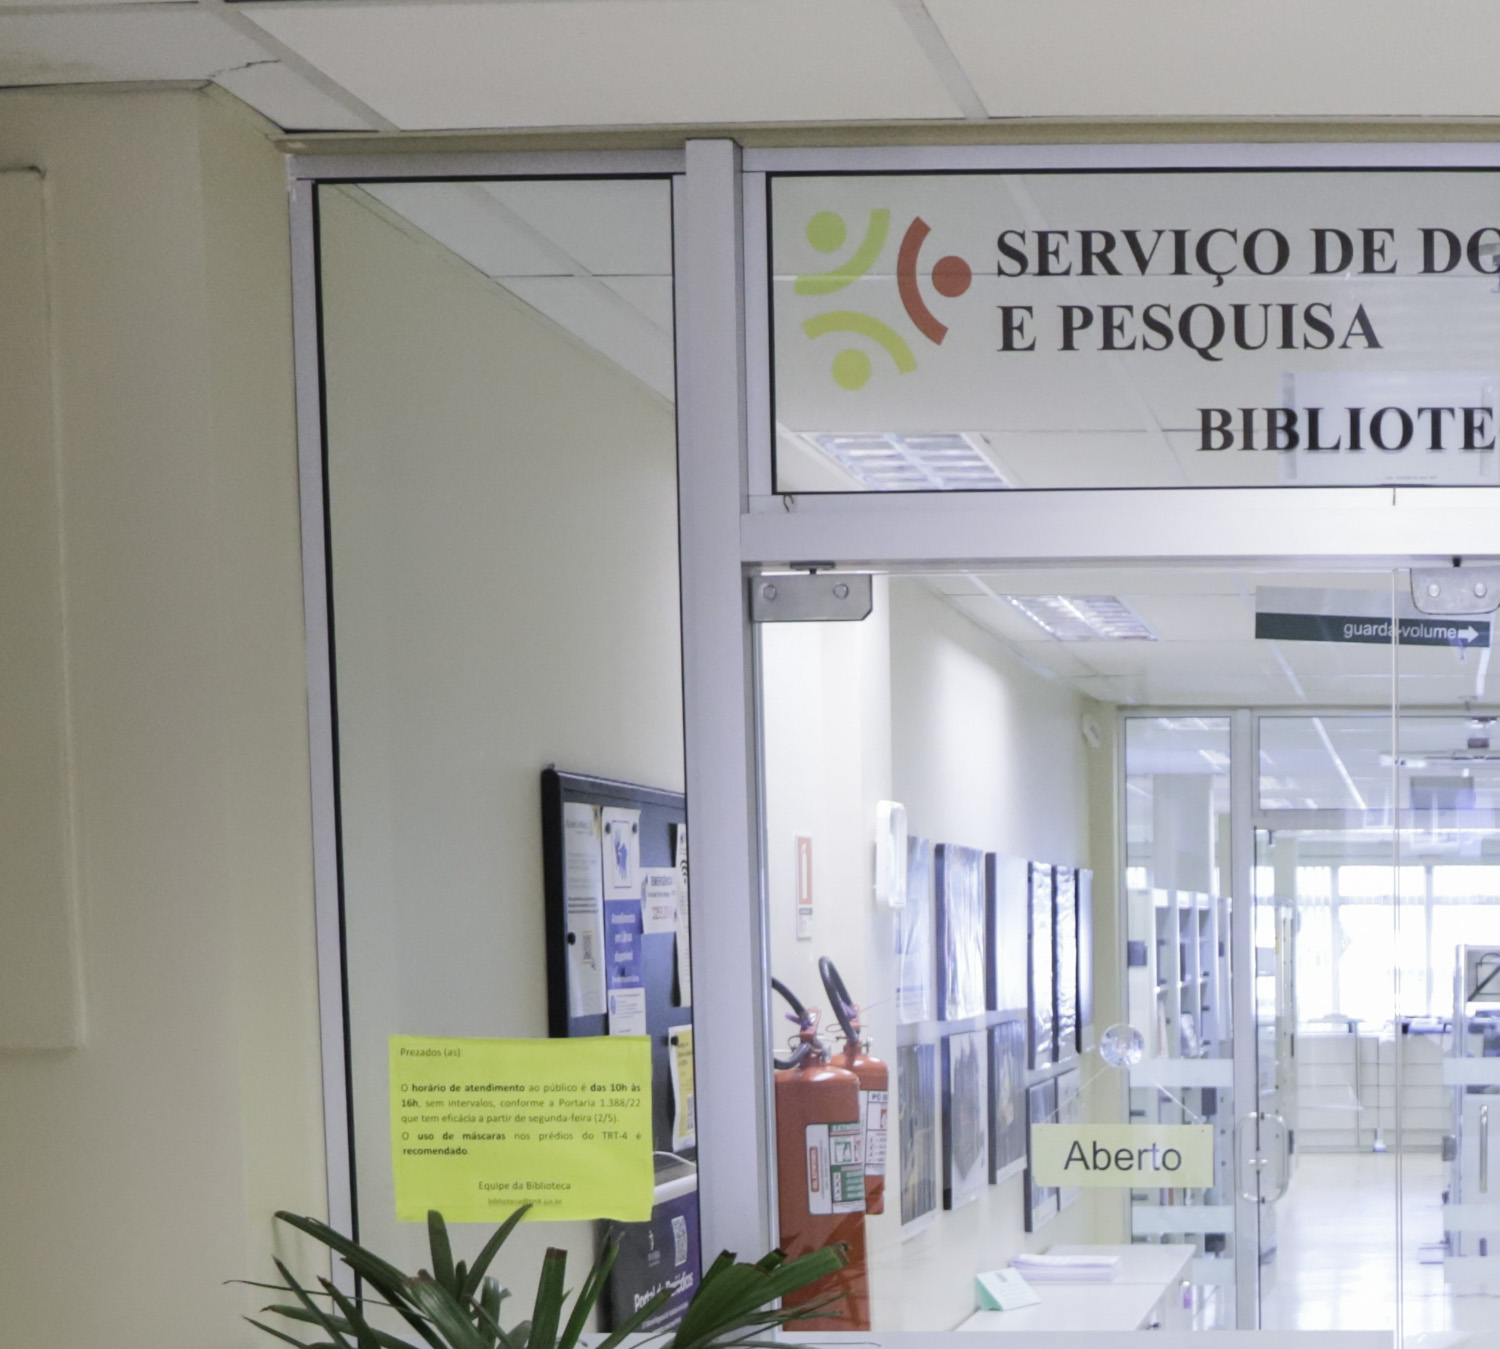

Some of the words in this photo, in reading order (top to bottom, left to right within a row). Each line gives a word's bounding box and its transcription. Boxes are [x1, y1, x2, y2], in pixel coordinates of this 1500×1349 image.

[997, 228, 1290, 287] SERVIÇO
[1313, 228, 1397, 274] DE
[998, 306, 1036, 352] E
[1059, 302, 1382, 362] PESQUISA
[400, 1048, 441, 1056] Prezados
[401, 1084, 408, 1092] O
[412, 1083, 446, 1092] horário
[449, 1084, 461, 1092] de
[464, 1083, 525, 1092] atendimento
[543, 1083, 578, 1093] público
[581, 1084, 587, 1092] é
[590, 1083, 607, 1092] das
[610, 1083, 628, 1092] 10h
[631, 1083, 641, 1092] às
[448, 1099, 496, 1109] intervalos,
[500, 1099, 544, 1107] conforme
[559, 1099, 596, 1107] Portaria
[401, 1115, 419, 1124] que
[421, 1114, 439, 1122] tem
[441, 1113, 476, 1122] eficácia
[486, 1113, 512, 1124] partir
[514, 1113, 527, 1122] de
[528, 1113, 592, 1124] segunda-feira
[402, 1131, 409, 1140] O
[442, 1131, 454, 1140] de
[462, 1131, 506, 1140] máscaras
[539, 1131, 574, 1141] prédios
[582, 1131, 594, 1140] do
[602, 1131, 628, 1140] TRT-4
[636, 1132, 642, 1140] é
[1063, 1140, 1183, 1172] Aberto
[478, 1182, 510, 1191] Equipe
[512, 1182, 523, 1190] da
[526, 1181, 571, 1190] Biblioteca
